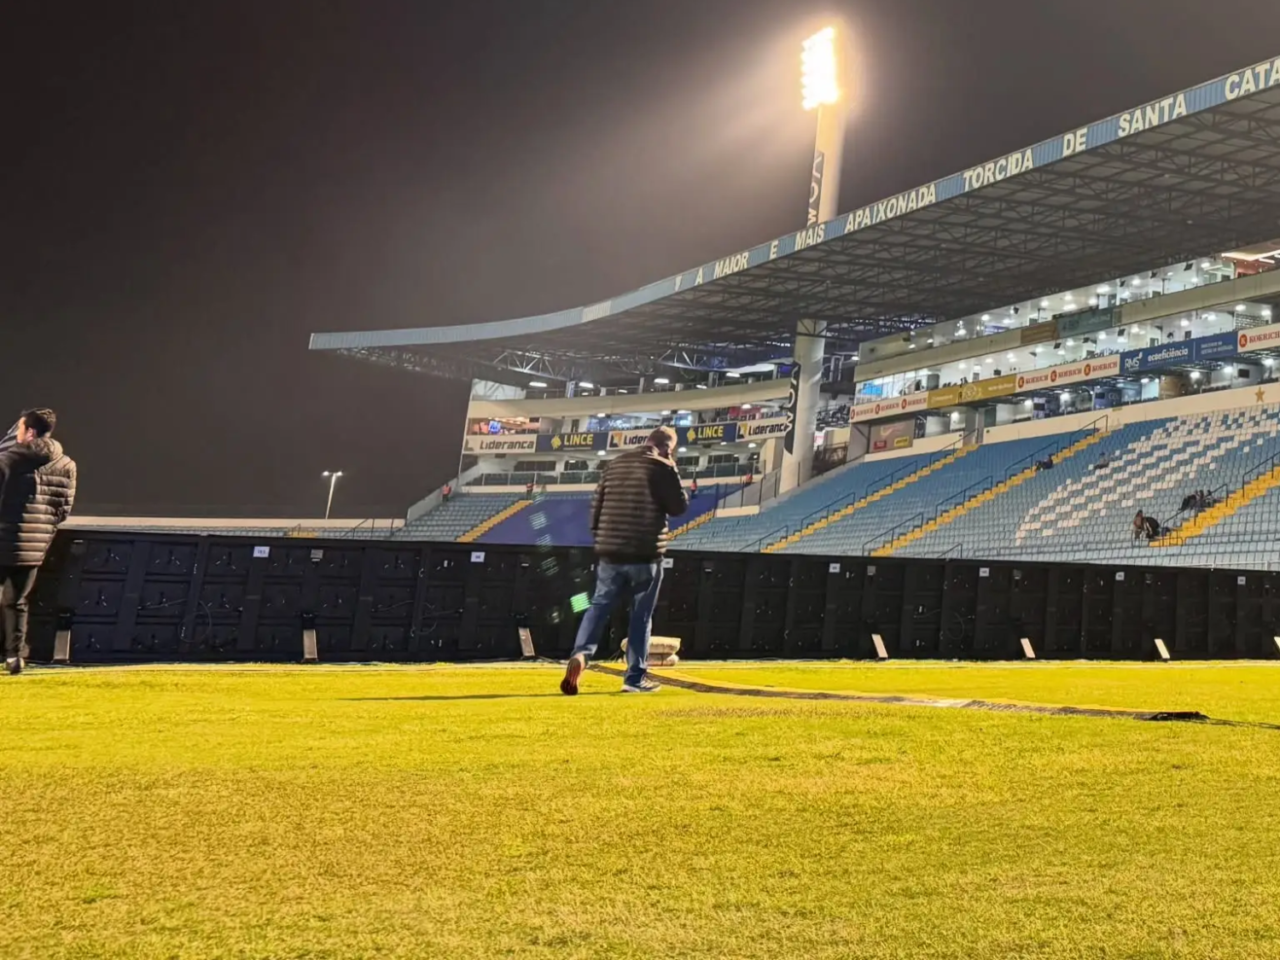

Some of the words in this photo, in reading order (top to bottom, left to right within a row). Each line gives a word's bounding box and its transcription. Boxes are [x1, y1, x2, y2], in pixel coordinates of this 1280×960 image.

[694, 267, 703, 286] A
[713, 251, 749, 280] MAIOR
[769, 240, 779, 260] E
[794, 224, 826, 251] MAIS
[844, 183, 937, 234] APAIXONADA
[963, 148, 1034, 192] TORCIDA
[1062, 127, 1089, 157] DE
[1117, 93, 1188, 138] SANTA
[697, 425, 724, 439] LINCE
[564, 433, 594, 446] LINCE
